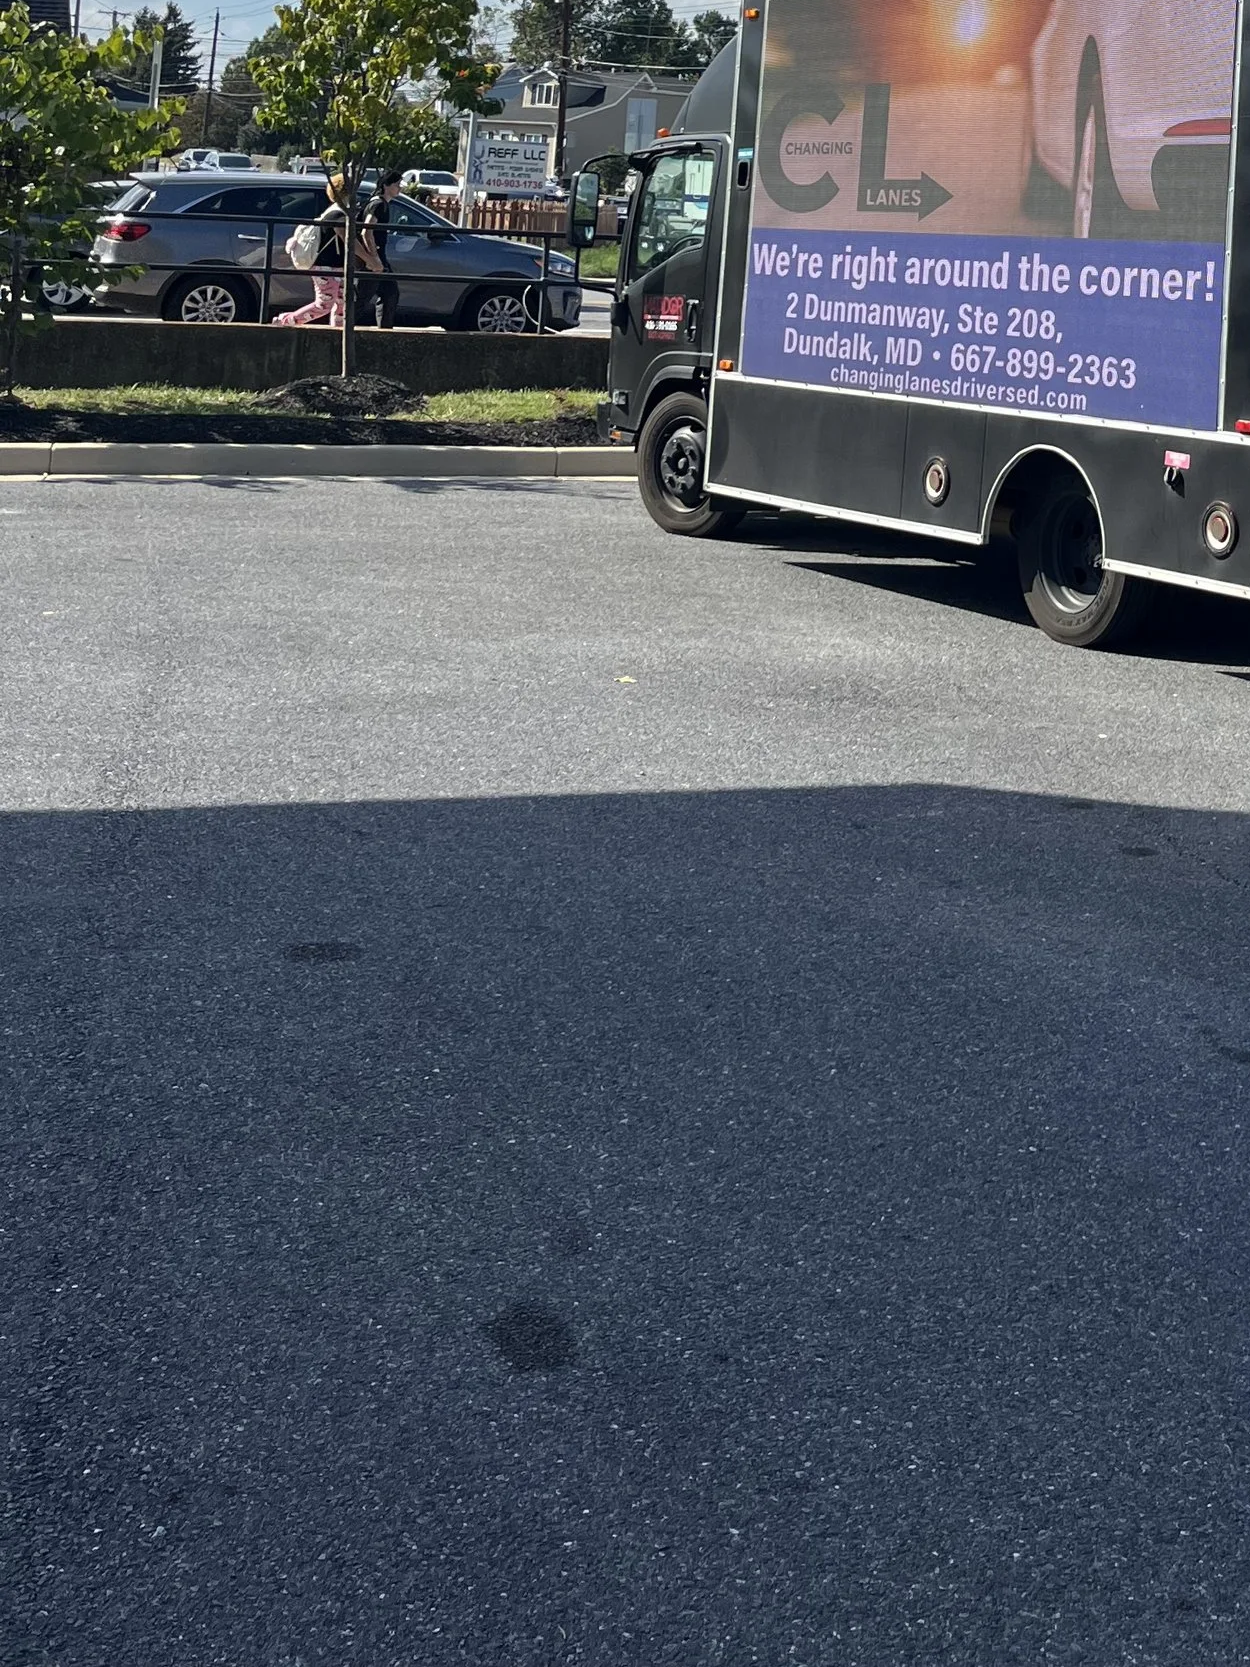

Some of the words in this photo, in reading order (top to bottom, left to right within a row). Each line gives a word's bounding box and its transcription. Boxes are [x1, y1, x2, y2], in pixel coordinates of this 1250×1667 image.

[488, 147, 519, 159] REFF
[524, 149, 546, 161] LLC
[785, 142, 853, 155] CHANGING
[866, 189, 921, 206] LANES
[753, 243, 822, 278] We're
[831, 246, 898, 290] right
[904, 251, 1009, 291] around
[1018, 253, 1070, 294] the
[1079, 261, 1216, 302] corner!
[786, 292, 798, 319] 2
[804, 294, 950, 339] Dunmanway,
[957, 304, 999, 335] Ste
[1006, 309, 1063, 344] 208,
[783, 327, 880, 366] Dundalk,
[885, 340, 923, 368] MD
[950, 343, 1138, 390] 667-899-2363
[830, 364, 1088, 412] changinglanesdriversed.com
